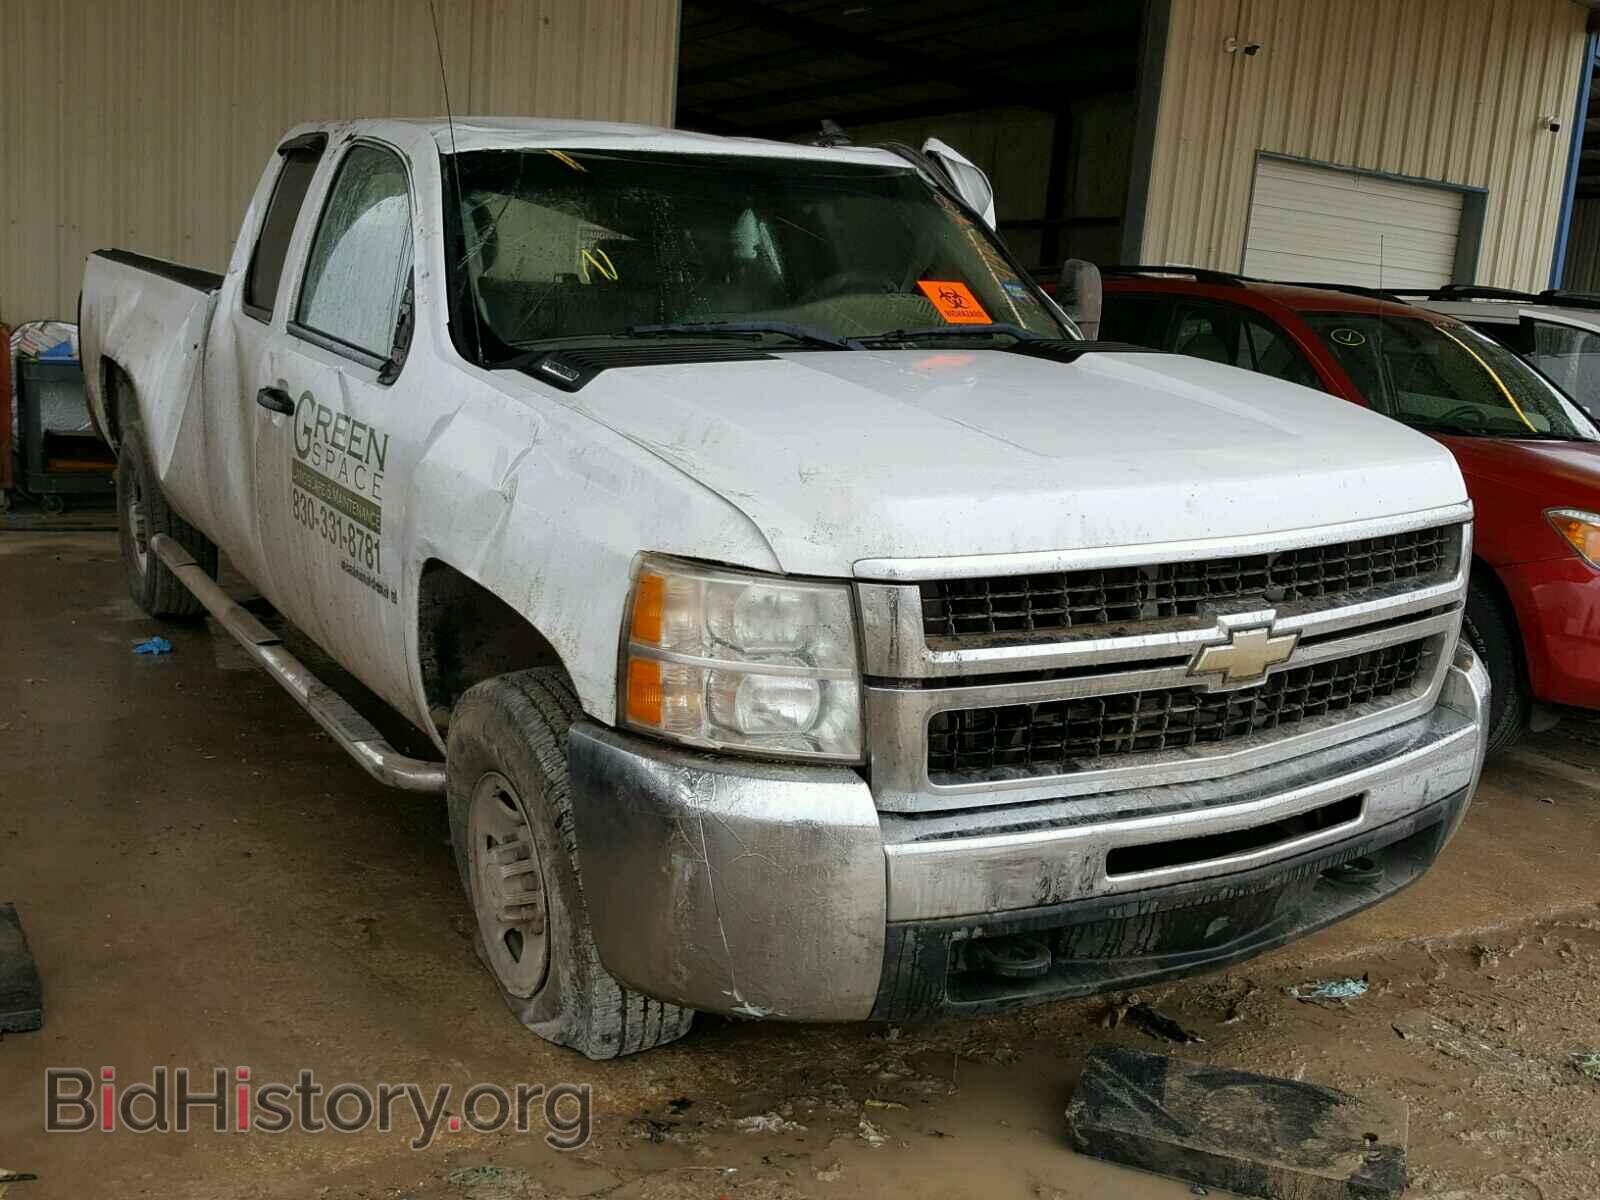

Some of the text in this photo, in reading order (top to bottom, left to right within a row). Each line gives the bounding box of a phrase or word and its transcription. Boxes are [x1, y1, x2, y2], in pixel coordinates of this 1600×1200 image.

[294, 390, 389, 472] GREEN
[312, 442, 384, 501] SPACE
[293, 488, 381, 575] 830-331-8781
